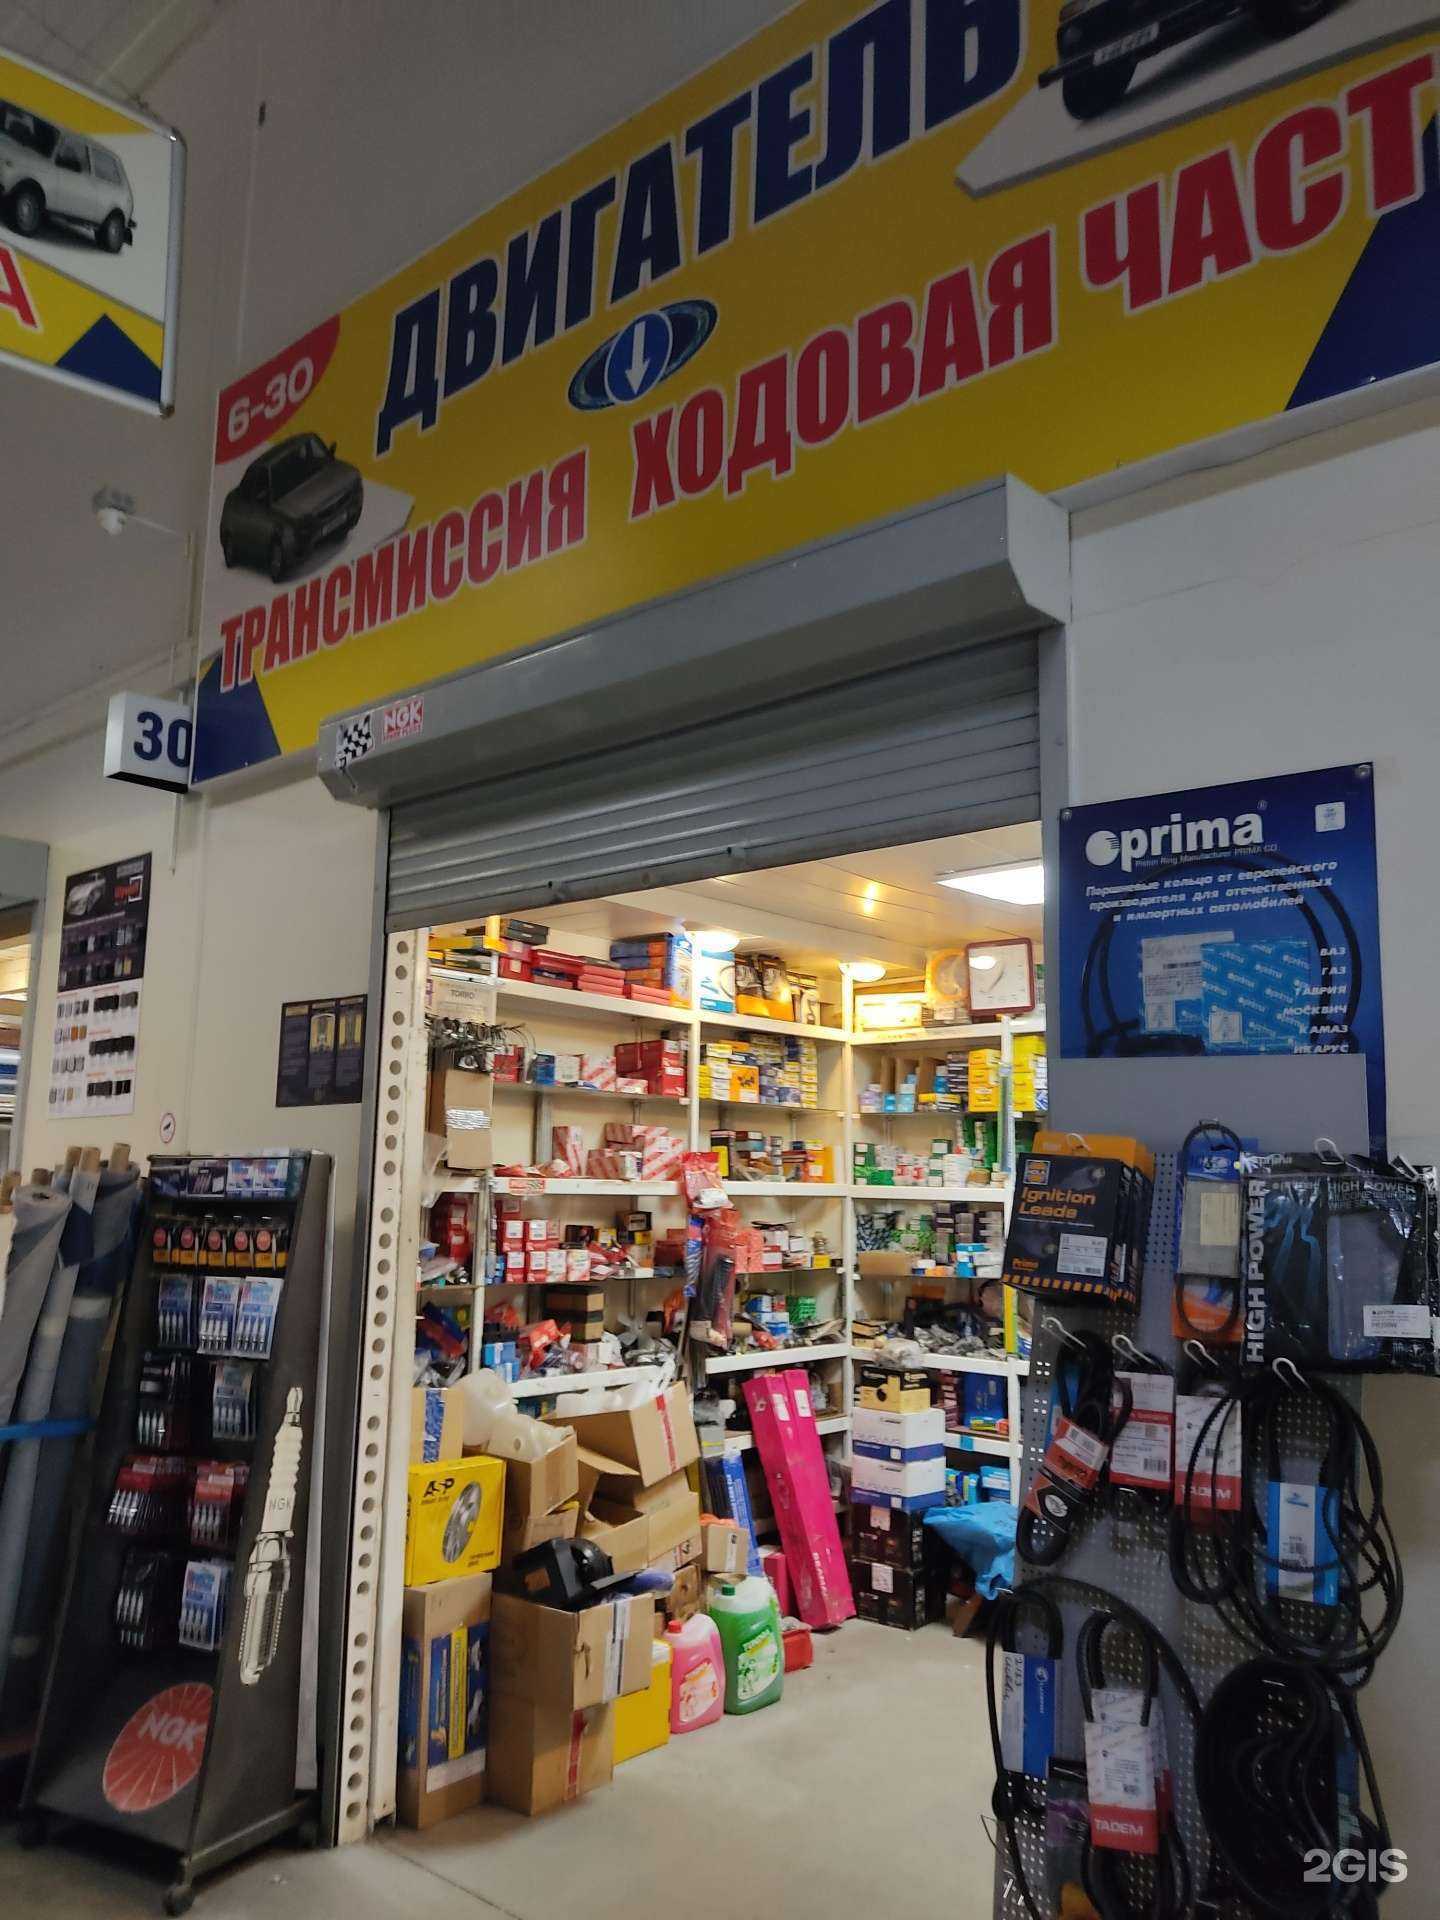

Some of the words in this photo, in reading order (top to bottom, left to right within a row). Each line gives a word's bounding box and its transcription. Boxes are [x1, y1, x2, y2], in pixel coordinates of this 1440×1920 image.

[375, 0, 1021, 456] ДВИГАТЕЛЬ
[632, 231, 1053, 519] ХОДОВАЯ
[1083, 54, 1435, 309] ЧАСТ
[228, 357, 313, 442] 6-30
[219, 448, 588, 692] ТРАНСМИССИЯ
[384, 700, 424, 734] NGK
[134, 711, 190, 767] 30
[1160, 856, 1178, 866] Ring
[1234, 844, 1262, 856] PRIMA
[1086, 880, 1161, 897] Поршневые
[1217, 873, 1232, 884] от
[1238, 860, 1339, 881] европейского
[1089, 892, 1186, 912] производителя
[1192, 889, 1219, 902] для
[1225, 876, 1334, 898] отечественных
[1126, 905, 1205, 924] импортных
[1208, 894, 1305, 914] автомобилей
[1319, 947, 1346, 957] ВАЗ
[1322, 966, 1347, 976] ГАЗ
[1283, 1004, 1348, 1015] МОСКВИЧ
[1301, 1024, 1349, 1034] КАМАЗ
[1294, 1044, 1350, 1054] ИКАРУС
[1021, 1187, 1097, 1205] Ignition
[1327, 1181, 1359, 1193] HIGH
[1018, 1202, 1078, 1219] Leads
[1247, 1179, 1266, 1281] POWER
[1247, 1288, 1265, 1364] HIGH
[268, 1495, 293, 1512] NGK
[138, 1710, 207, 1754] NGK
[1094, 1817, 1145, 1837] TADEM
